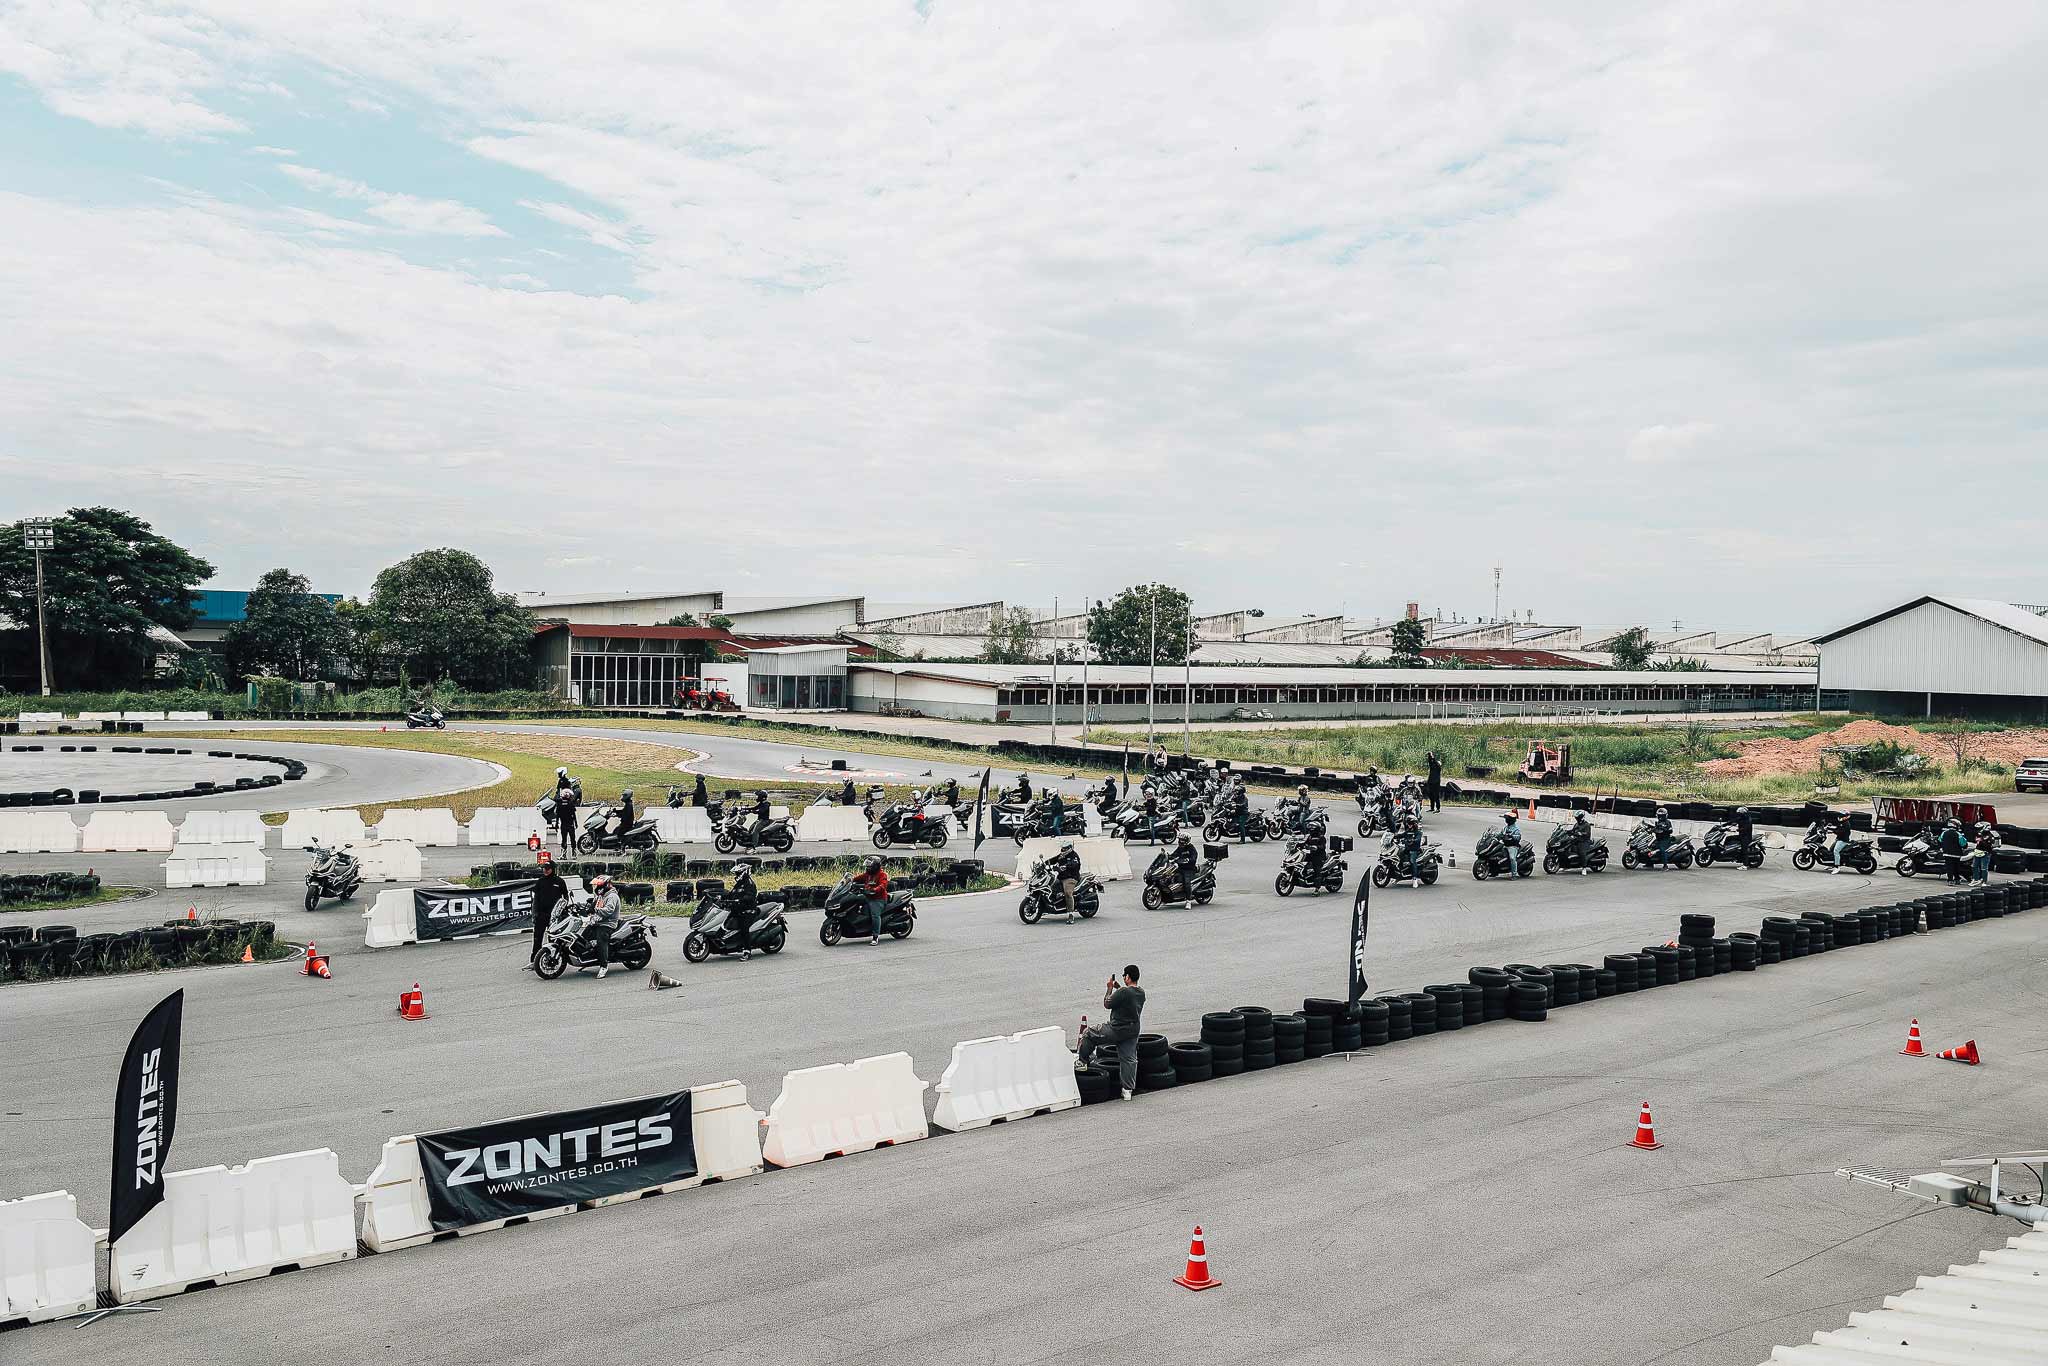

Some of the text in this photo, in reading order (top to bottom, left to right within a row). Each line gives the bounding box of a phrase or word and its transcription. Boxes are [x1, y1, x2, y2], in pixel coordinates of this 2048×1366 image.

[427, 890, 535, 919] ZONTE
[136, 1047, 162, 1190] ZONTES
[444, 1112, 673, 1187] ZONTES
[487, 1156, 639, 1195] WWW.ZONTES.CO.TH
